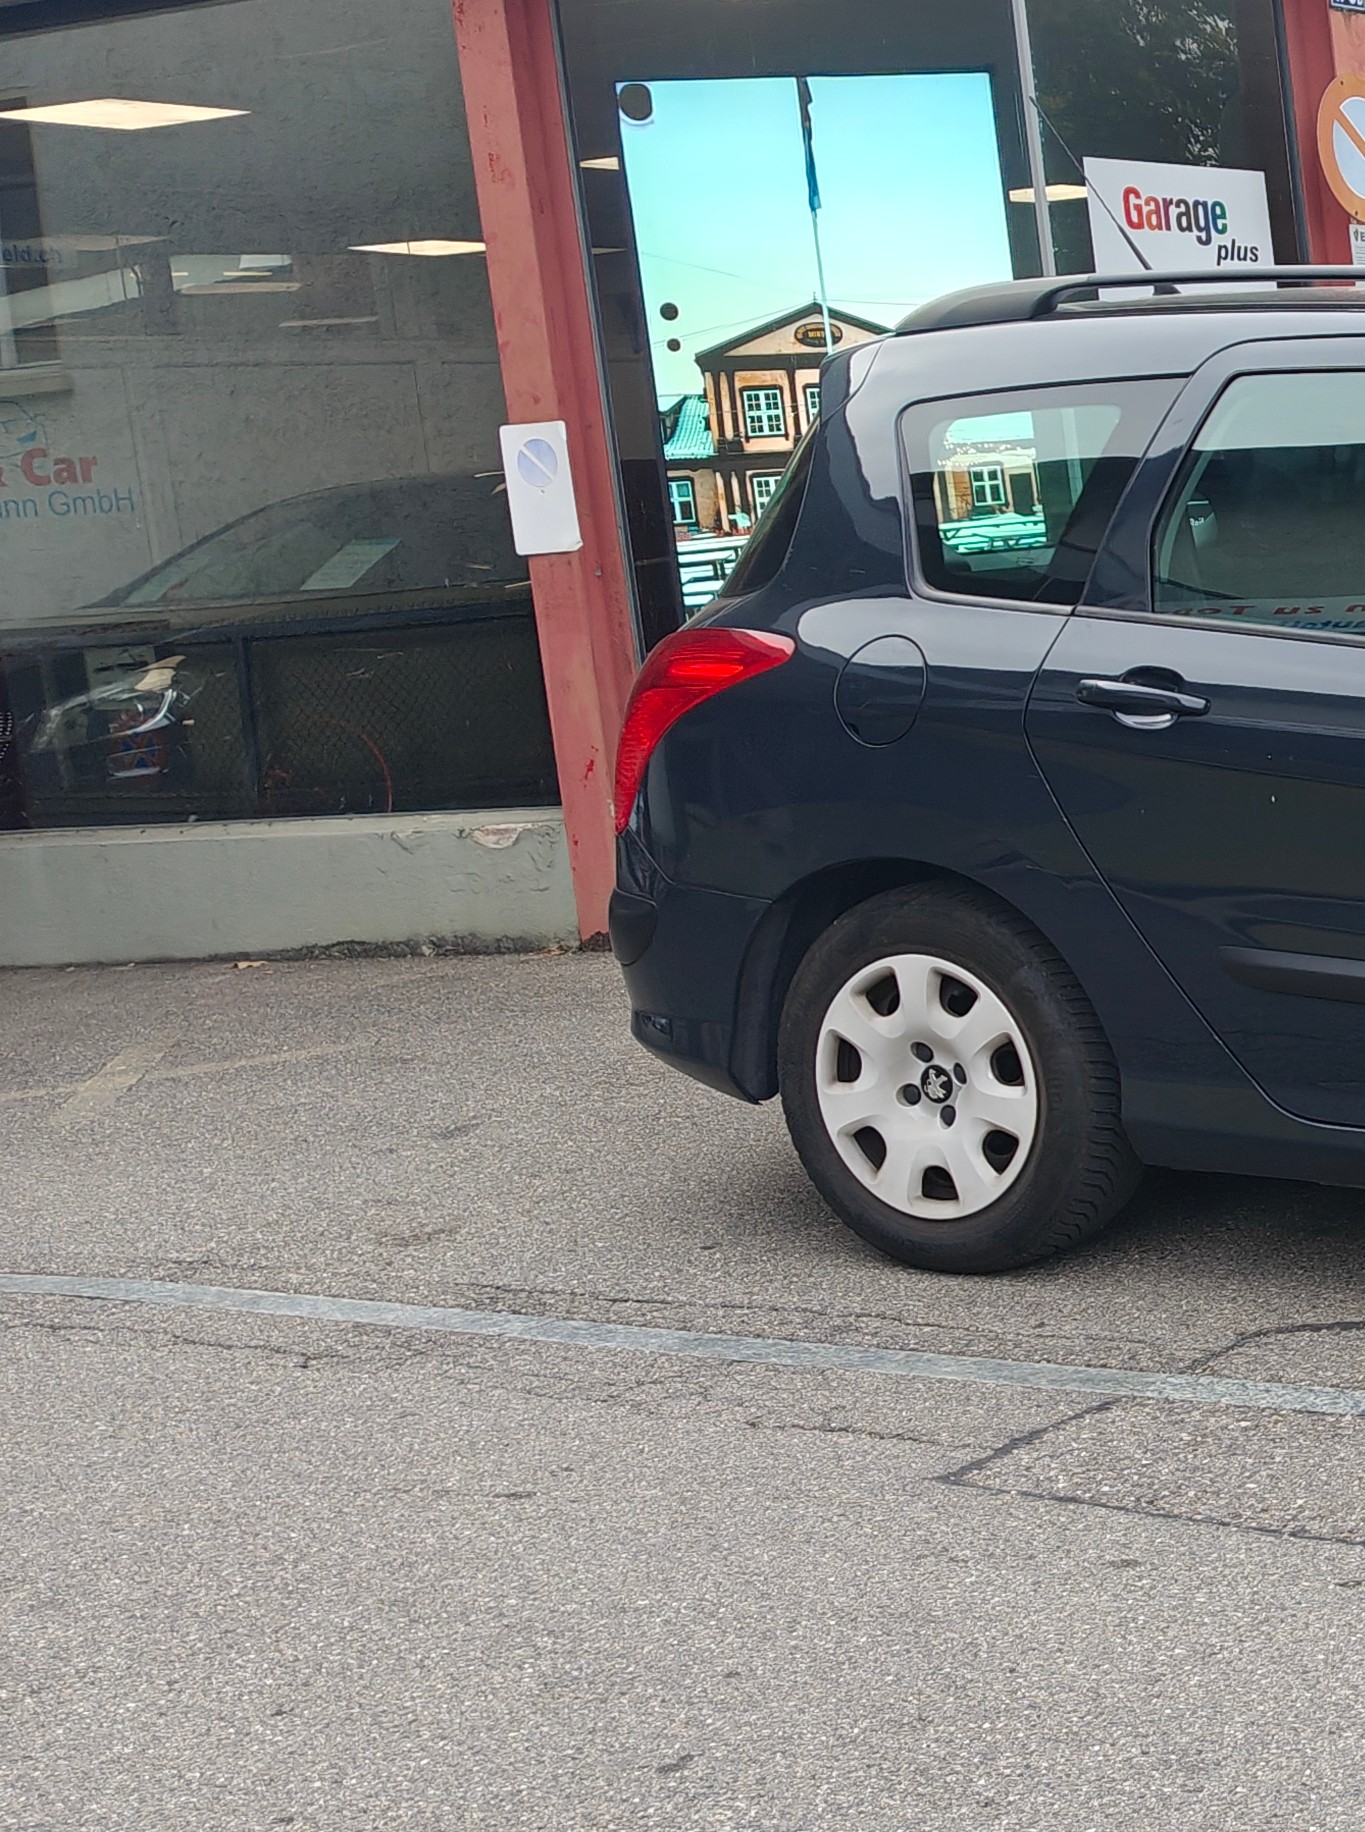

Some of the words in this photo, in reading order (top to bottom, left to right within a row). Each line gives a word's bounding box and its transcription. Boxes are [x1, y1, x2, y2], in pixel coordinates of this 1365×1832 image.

[1121, 185, 1228, 246] Garage
[1216, 238, 1259, 266] plus
[20, 447, 98, 486] Car
[48, 484, 134, 516] GmbH
